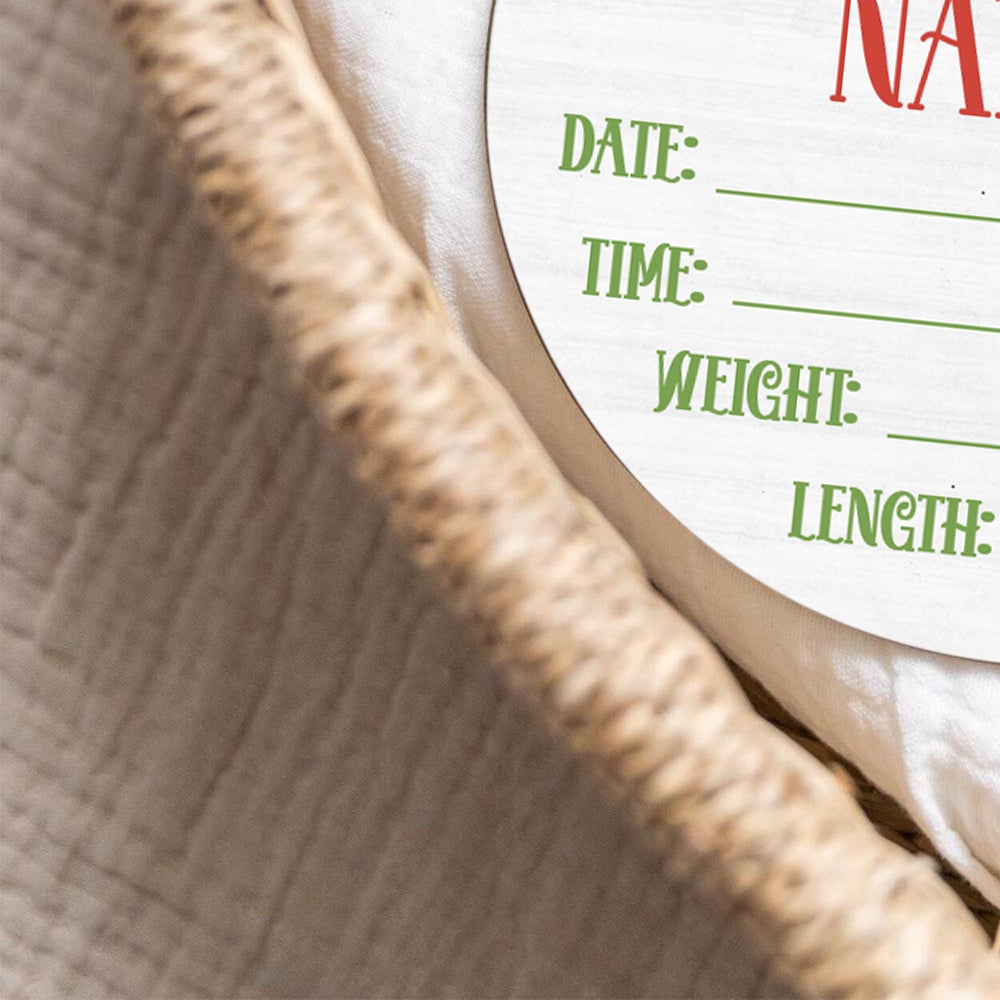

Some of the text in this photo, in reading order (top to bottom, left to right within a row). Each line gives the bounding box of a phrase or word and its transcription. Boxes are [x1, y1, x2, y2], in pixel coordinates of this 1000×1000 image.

[558, 113, 699, 183] DATE:
[582, 237, 708, 306] TIME:
[653, 350, 862, 427] WEIGHT:
[788, 481, 996, 557] LENGTH:
